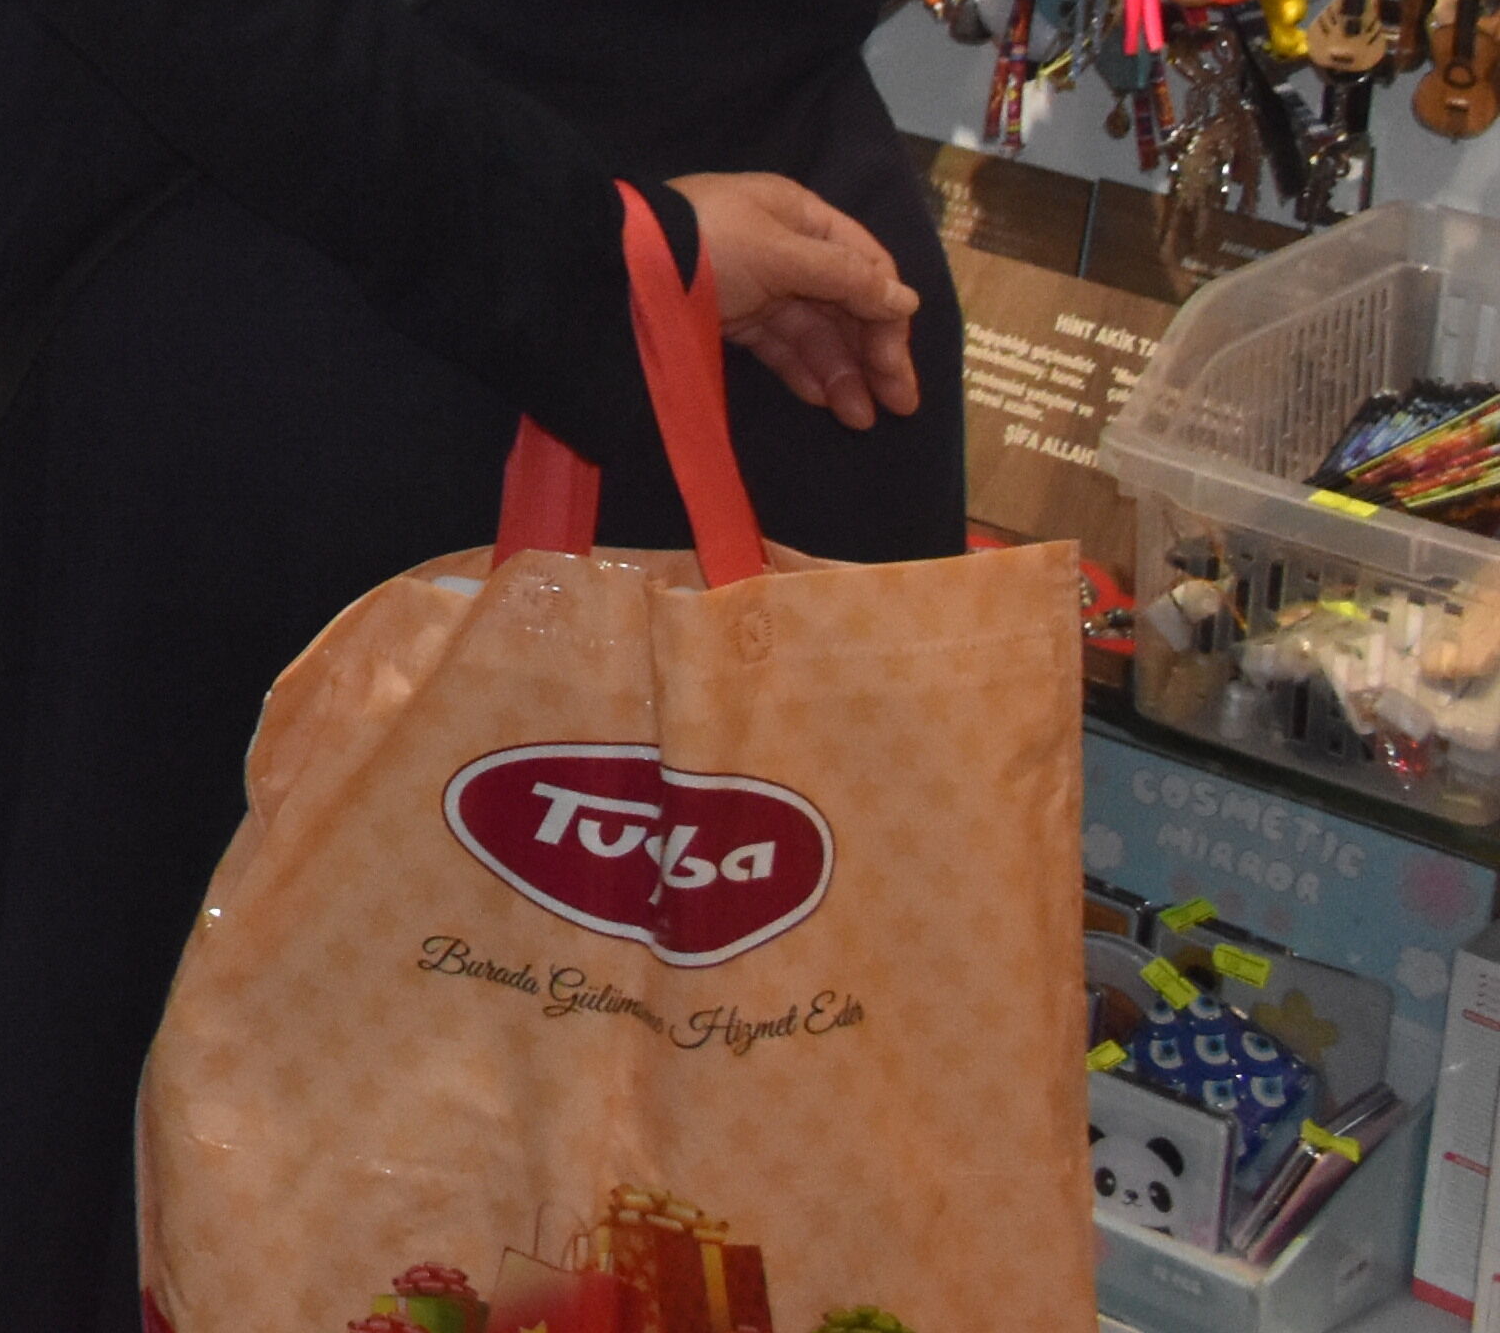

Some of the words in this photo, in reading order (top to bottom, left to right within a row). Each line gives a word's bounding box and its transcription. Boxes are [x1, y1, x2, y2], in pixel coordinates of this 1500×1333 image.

[1131, 767, 1367, 879] COSMETIC
[1155, 820, 1321, 906] MIRROR
[416, 934, 542, 997] Burada
[668, 1003, 798, 1057] Hizmet
[802, 989, 866, 1037] Eder
